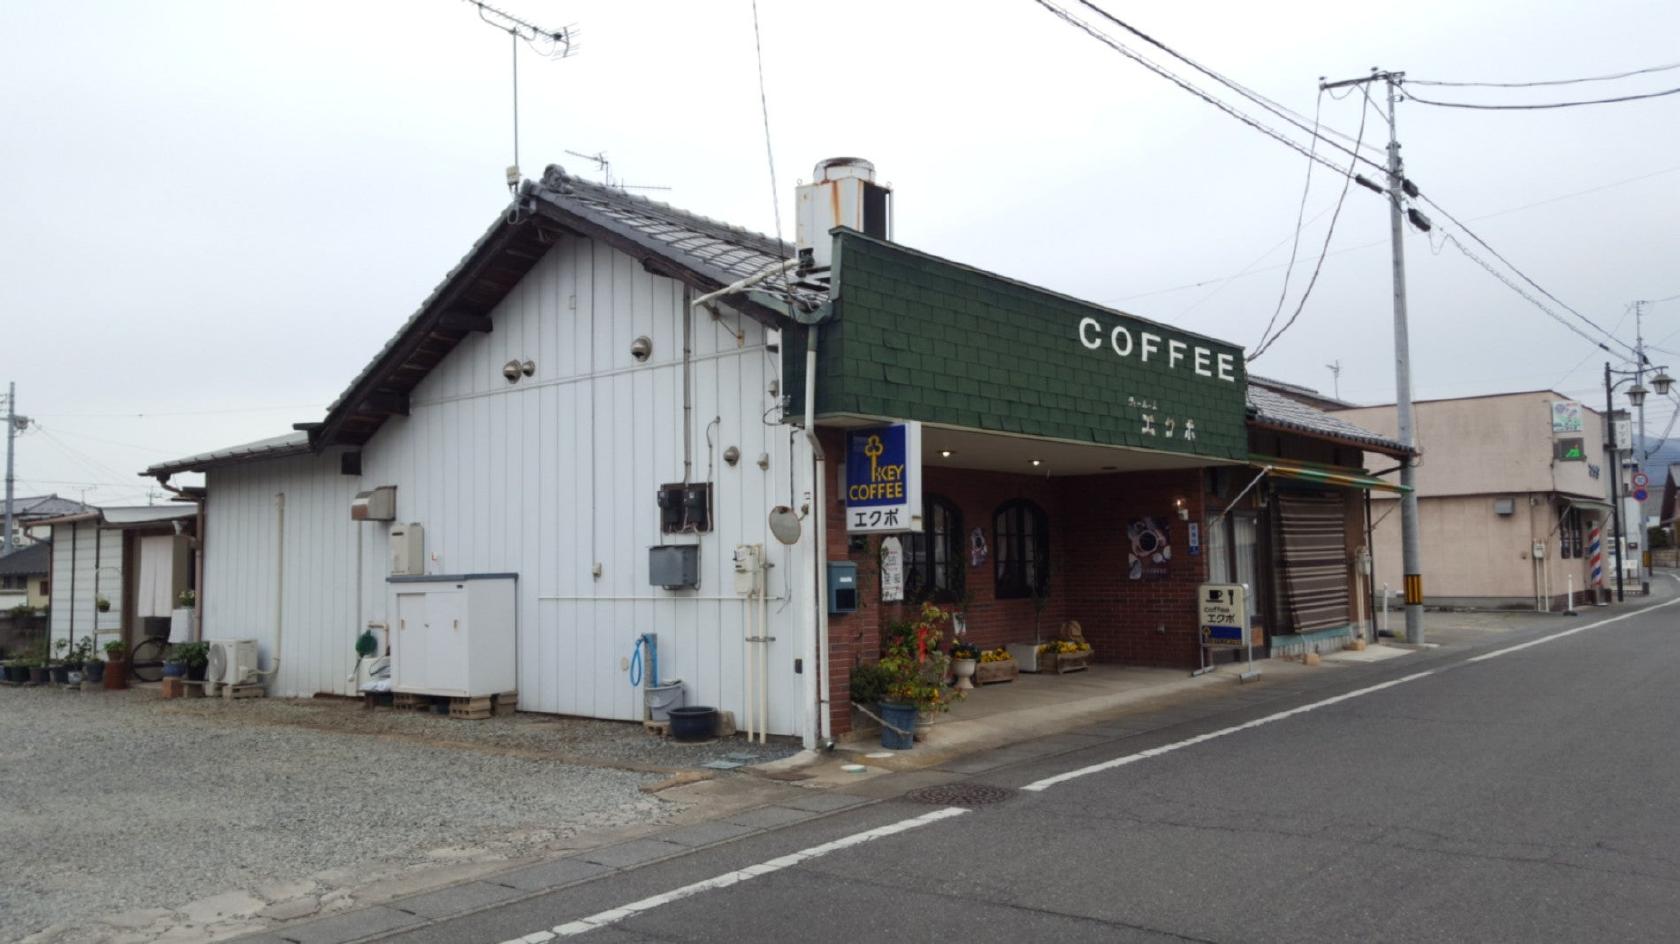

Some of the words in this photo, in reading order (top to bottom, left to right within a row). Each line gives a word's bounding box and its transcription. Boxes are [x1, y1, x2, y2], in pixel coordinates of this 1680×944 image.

[1079, 317, 1235, 382] COFFEE
[876, 464, 904, 481] KEY
[849, 482, 904, 501] COFFEE
[854, 507, 899, 527] エクボ
